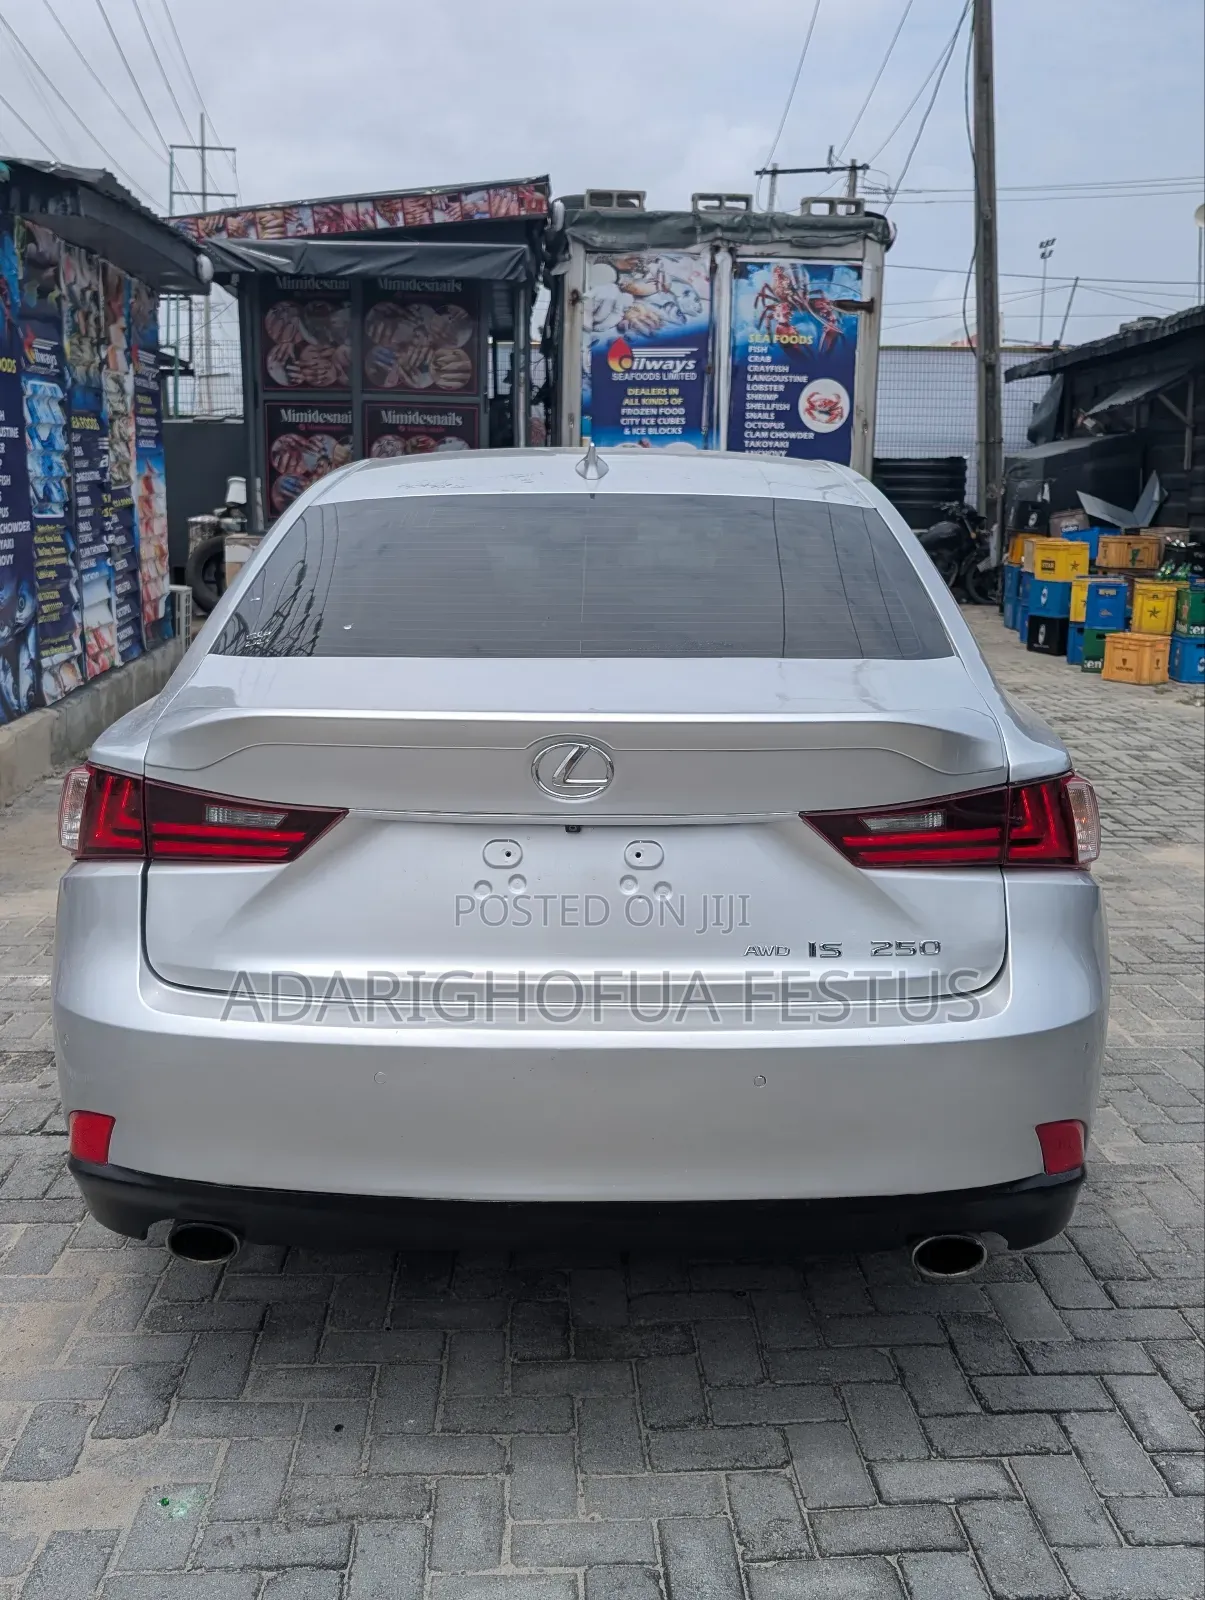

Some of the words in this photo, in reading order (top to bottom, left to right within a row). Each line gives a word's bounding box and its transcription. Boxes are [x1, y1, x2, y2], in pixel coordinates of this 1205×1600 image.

[748, 334, 771, 344] SEA
[772, 335, 814, 344] FOODS
[748, 346, 768, 354] FISH
[748, 355, 772, 363] CRAB
[747, 365, 790, 373] CRAYFISH
[612, 372, 662, 381] SEAFOODS
[662, 372, 697, 381] LIMITED
[746, 374, 809, 383] LANGOUSTINE
[627, 388, 668, 396] DEALERS
[668, 388, 679, 396] IN
[746, 384, 785, 392] LOBSTER
[746, 393, 779, 401] SHRIMP
[623, 398, 641, 406] ALL
[641, 398, 669, 406] KINDS
[670, 398, 684, 406] OF
[745, 403, 791, 411] SHELLFISH
[620, 408, 658, 416] FROZEN
[658, 408, 686, 416] FOOD
[745, 412, 775, 420] SNAILS
[381, 409, 463, 426] Mimidesnails
[620, 417, 641, 425] CITY
[641, 417, 656, 425] ICE
[657, 417, 686, 425] CUBES
[744, 421, 785, 429] OCTOPUS
[623, 427, 631, 435] &
[632, 427, 647, 435] ICE
[647, 427, 683, 435] BLOCKS
[744, 431, 769, 439] CLAM
[769, 431, 815, 440] CHOWDER
[744, 440, 789, 448] TAKOYAKI
[744, 944, 791, 957] AWD
[808, 941, 843, 959] IS
[870, 940, 942, 957] 250
